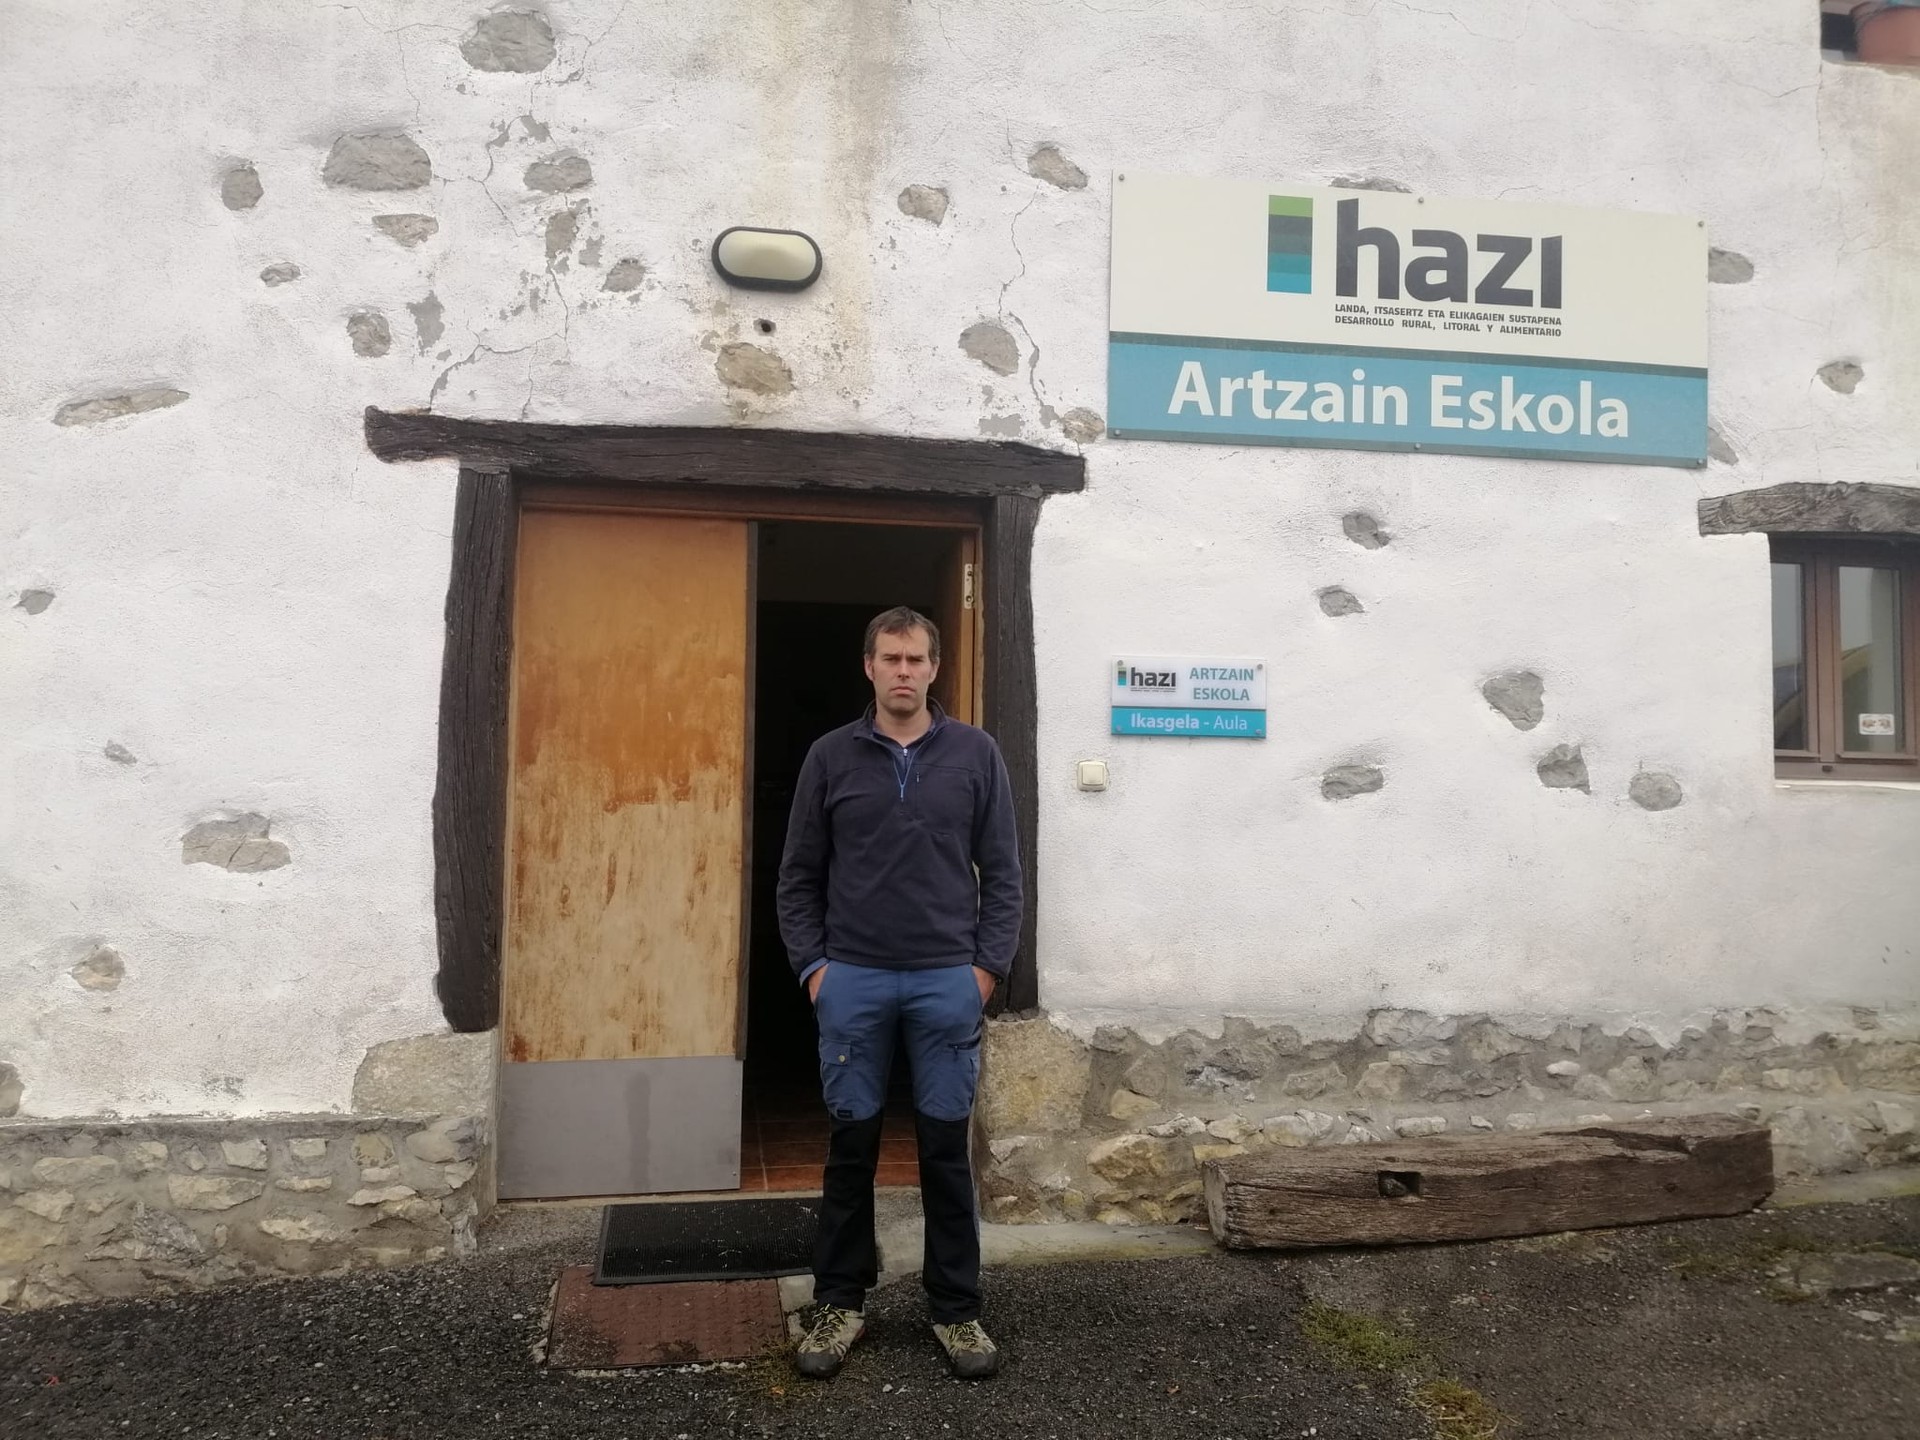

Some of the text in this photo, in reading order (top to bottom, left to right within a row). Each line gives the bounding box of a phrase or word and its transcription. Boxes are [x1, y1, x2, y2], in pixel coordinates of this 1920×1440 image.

[1335, 198, 1562, 309] hazi
[1335, 303, 1562, 326] LANDA, ITSASERTZ ETA ELIKAGAIEN SUSTAPENA
[1335, 315, 1562, 337] DESARROLLO RURAL, LITORAL Y ALIMENTARIO
[1167, 361, 1629, 438] Artzain Eskola
[1130, 667, 1176, 687] hazi
[1189, 667, 1254, 681] ARTZAIN
[1193, 687, 1250, 701] ESKOLA
[1131, 713, 1199, 732] Ikasgela
[1213, 715, 1248, 730] Aula
